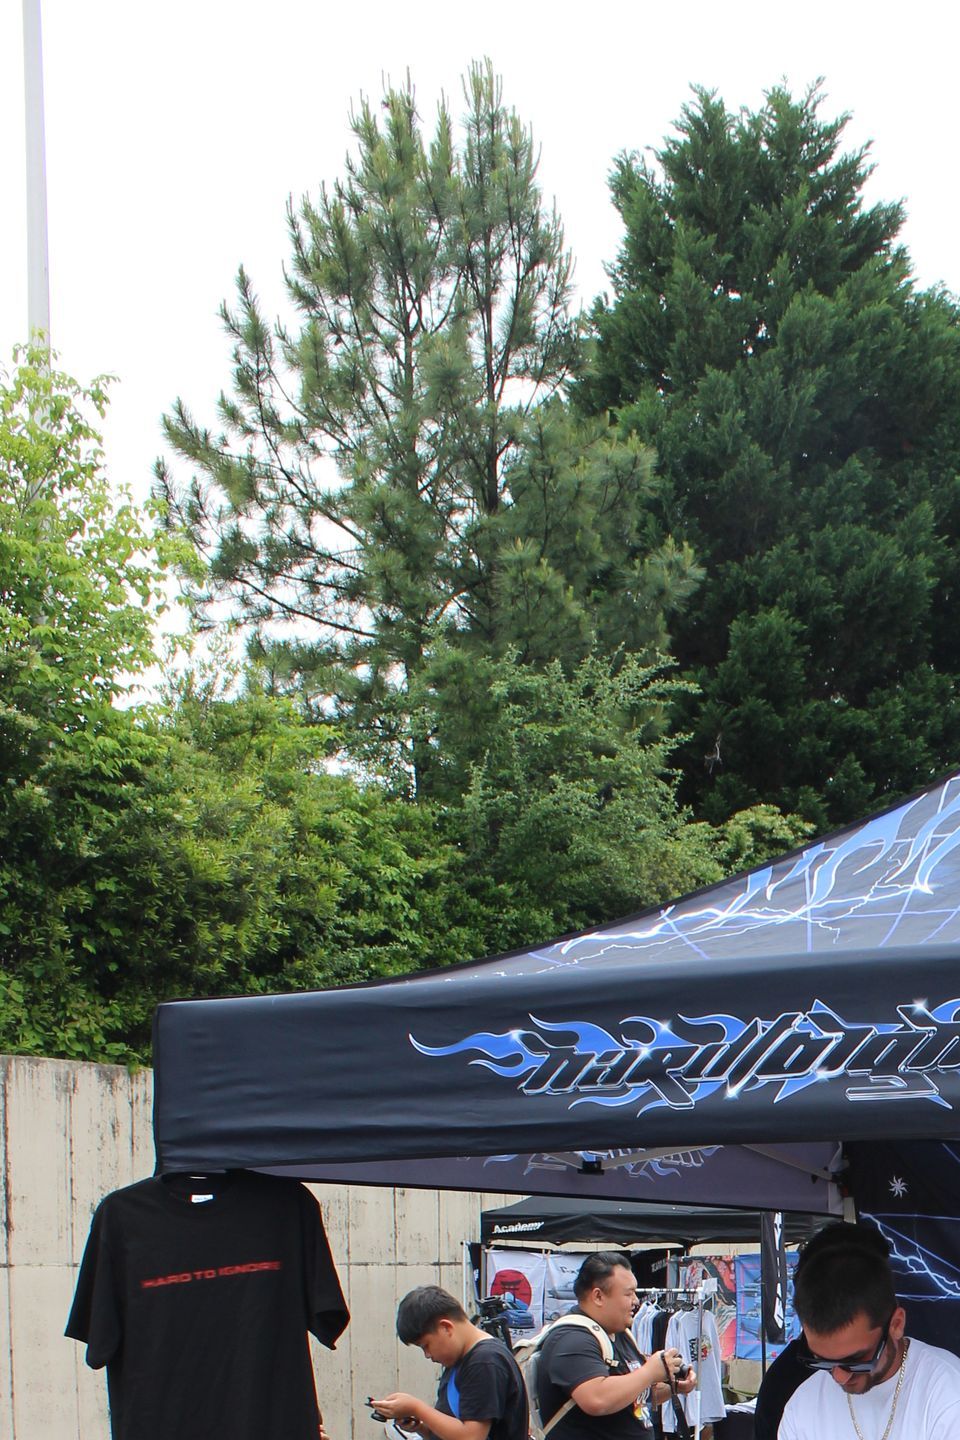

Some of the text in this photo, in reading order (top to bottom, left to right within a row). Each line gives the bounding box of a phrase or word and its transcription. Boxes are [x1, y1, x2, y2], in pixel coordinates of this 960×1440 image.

[491, 1221, 545, 1234] Academy
[141, 1260, 281, 1288] HARD TO IGNORE
